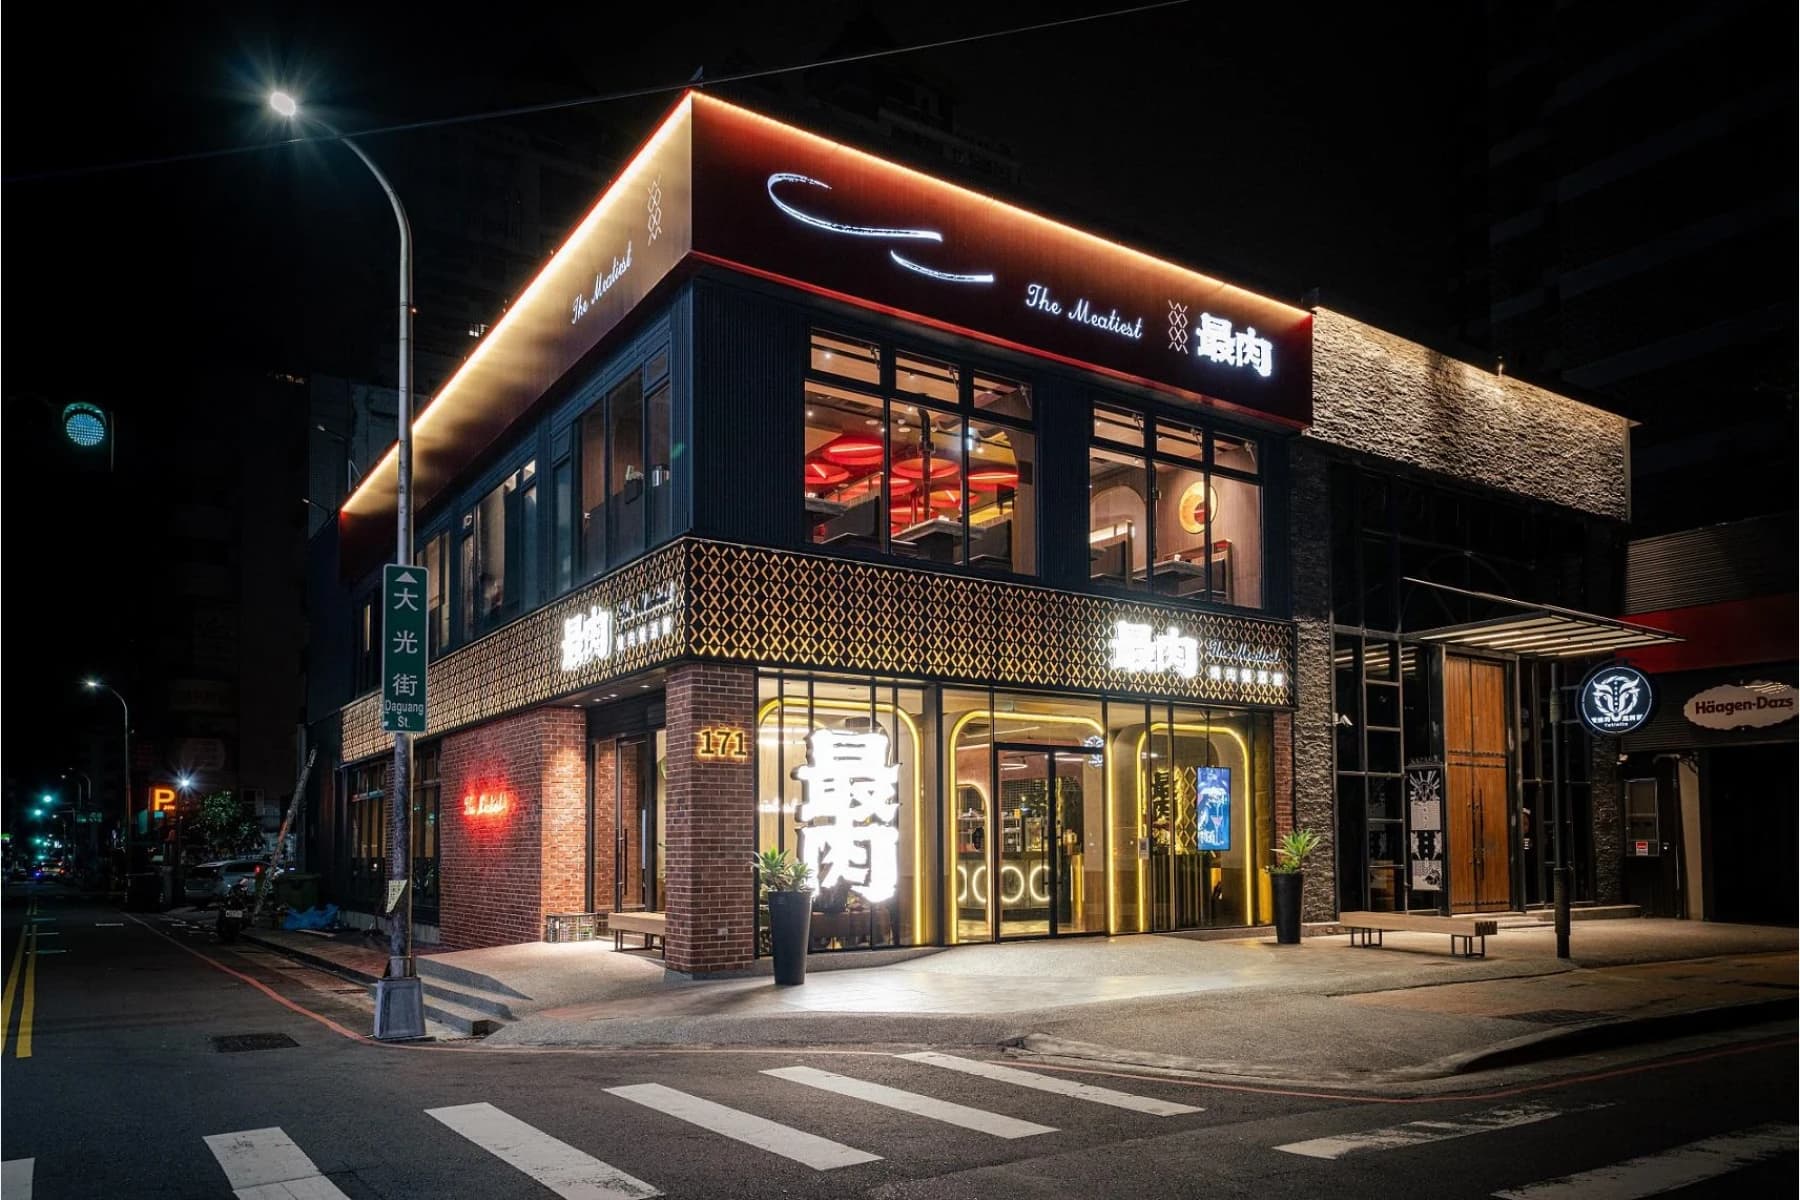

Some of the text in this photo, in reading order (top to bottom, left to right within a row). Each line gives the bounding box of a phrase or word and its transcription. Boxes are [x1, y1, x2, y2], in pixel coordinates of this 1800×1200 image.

[571, 240, 632, 324] The Meatiest
[1026, 284, 1143, 339] The Meatiest
[1196, 312, 1273, 378] 最肉
[393, 588, 419, 697] 大光街
[385, 699, 425, 716] Daguang
[397, 715, 410, 728] St.
[1695, 696, 1794, 716] Häagen-Dazs
[701, 730, 747, 756] 171
[153, 789, 175, 811] P
[792, 729, 900, 903] 最肉
